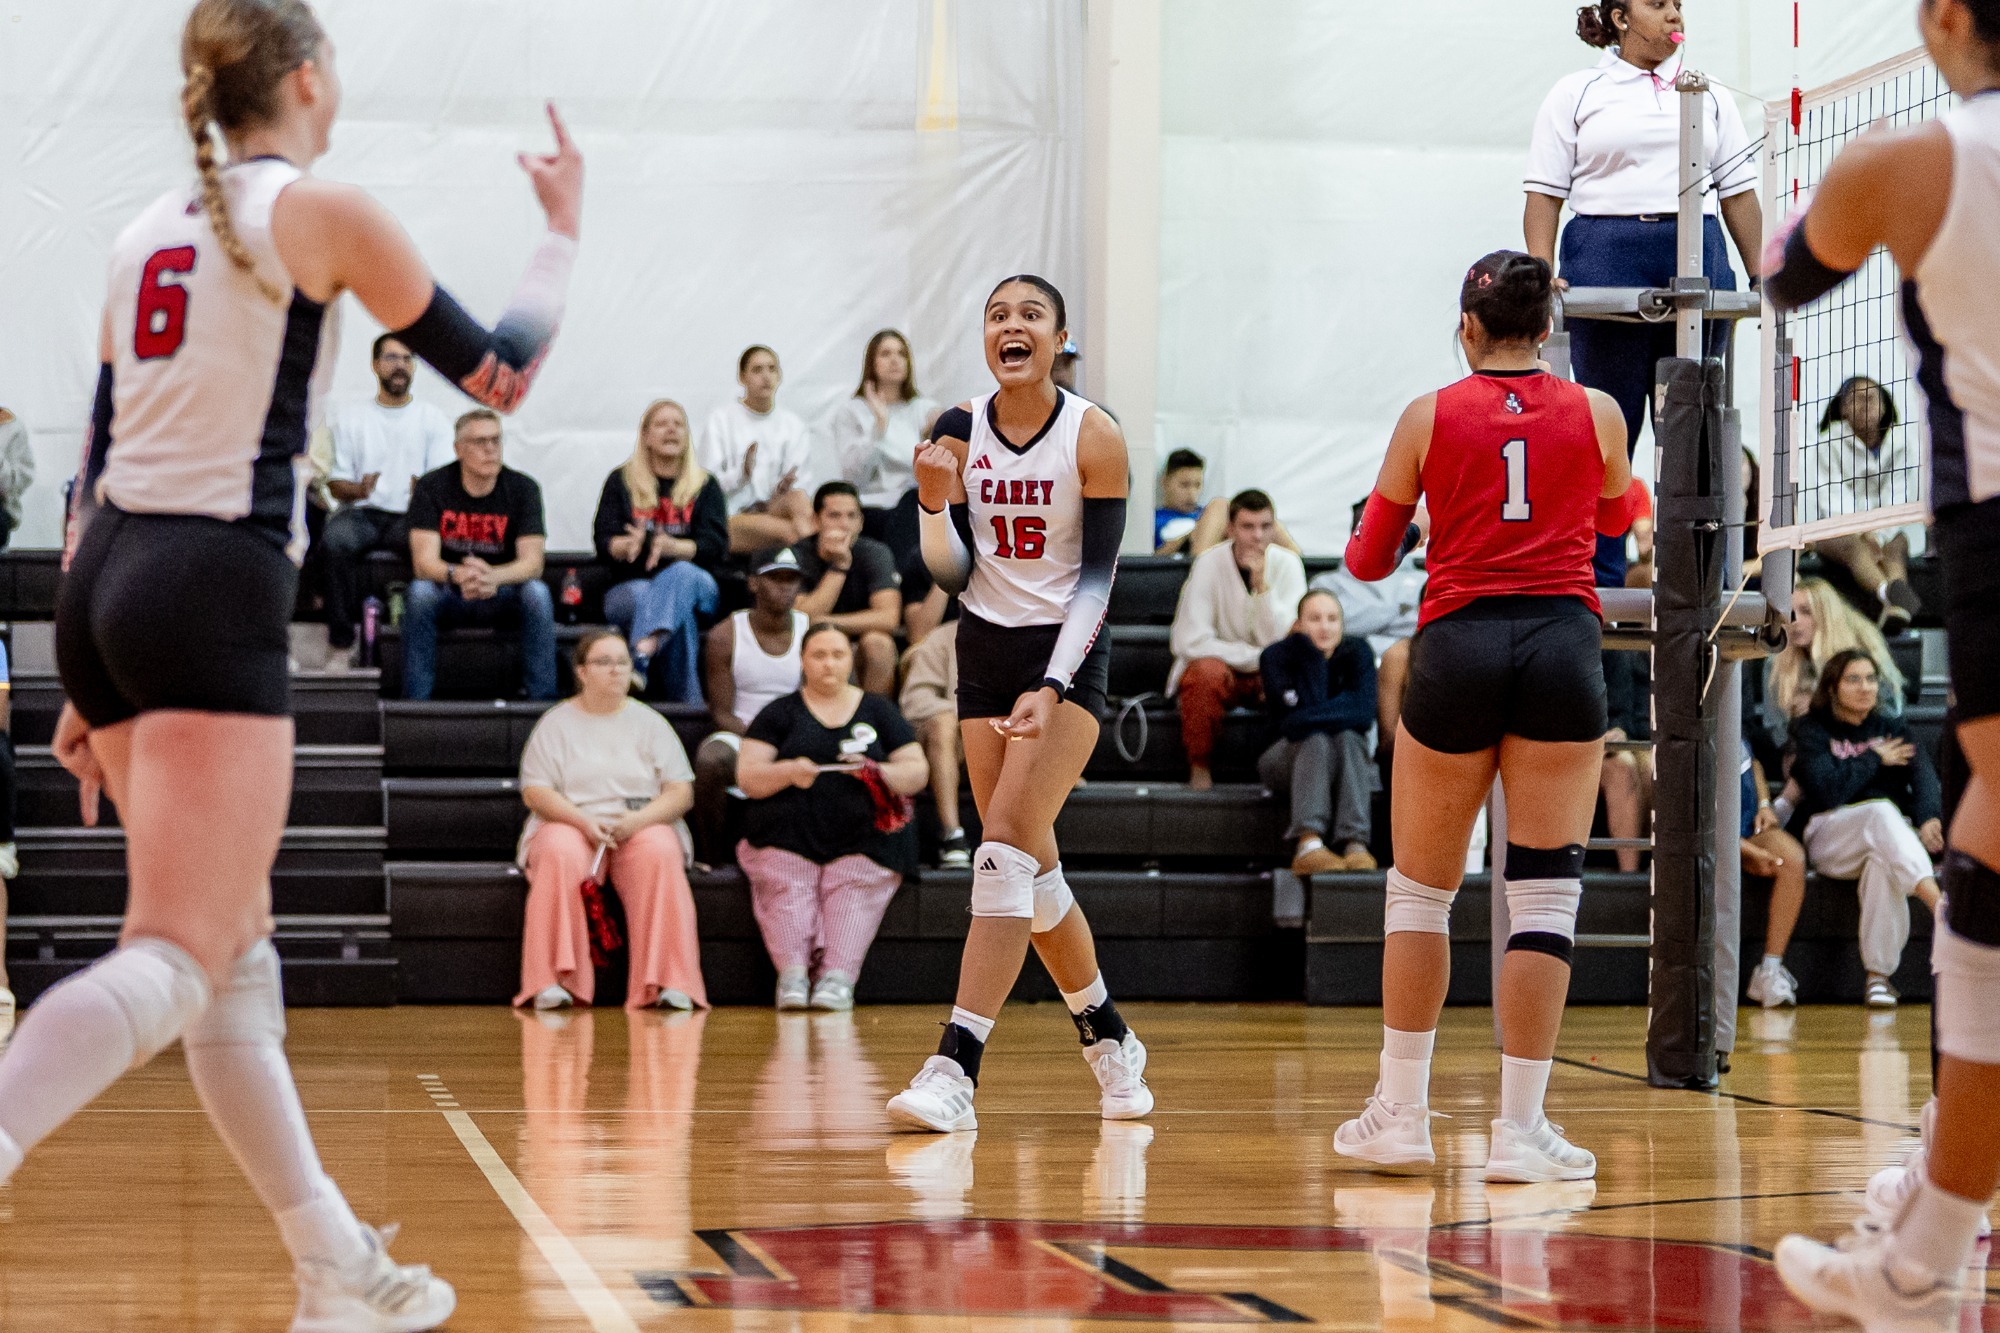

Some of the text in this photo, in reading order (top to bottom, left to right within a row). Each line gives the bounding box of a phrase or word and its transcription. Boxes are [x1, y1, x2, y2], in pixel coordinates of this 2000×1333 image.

[134, 245, 196, 360] 6
[981, 479, 1054, 505] CAREY
[1501, 438, 1532, 522] 1
[989, 515, 1047, 559] 16
